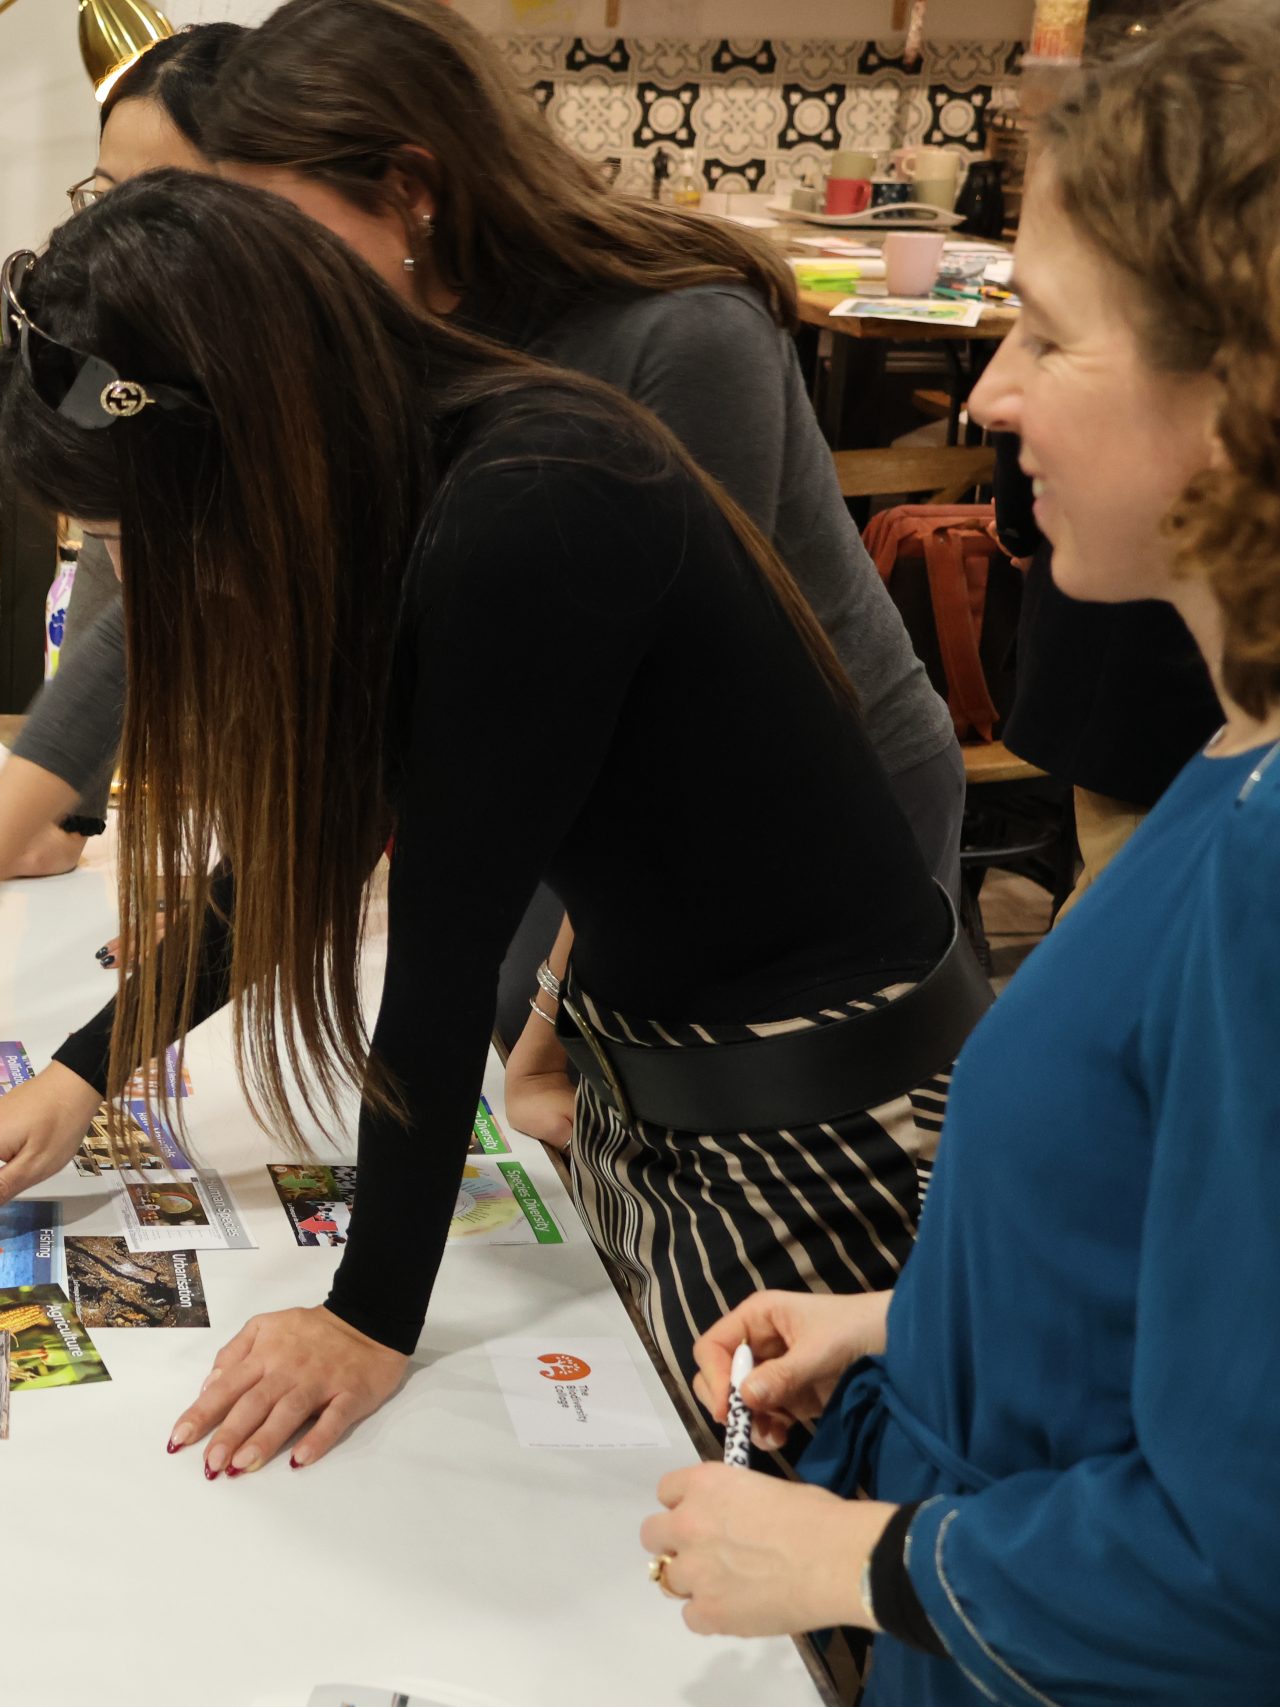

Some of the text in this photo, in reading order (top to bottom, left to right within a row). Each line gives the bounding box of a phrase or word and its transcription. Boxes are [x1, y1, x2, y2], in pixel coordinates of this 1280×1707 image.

[5, 1055, 24, 1085] Pollinatio
[475, 1119, 498, 1150] Diversity
[506, 1169, 551, 1233] Species Diversity
[215, 1208, 240, 1238] Species
[36, 1228, 54, 1259] Fishing
[171, 1253, 194, 1309] Urbanisation
[45, 1304, 85, 1357] Agriculture
